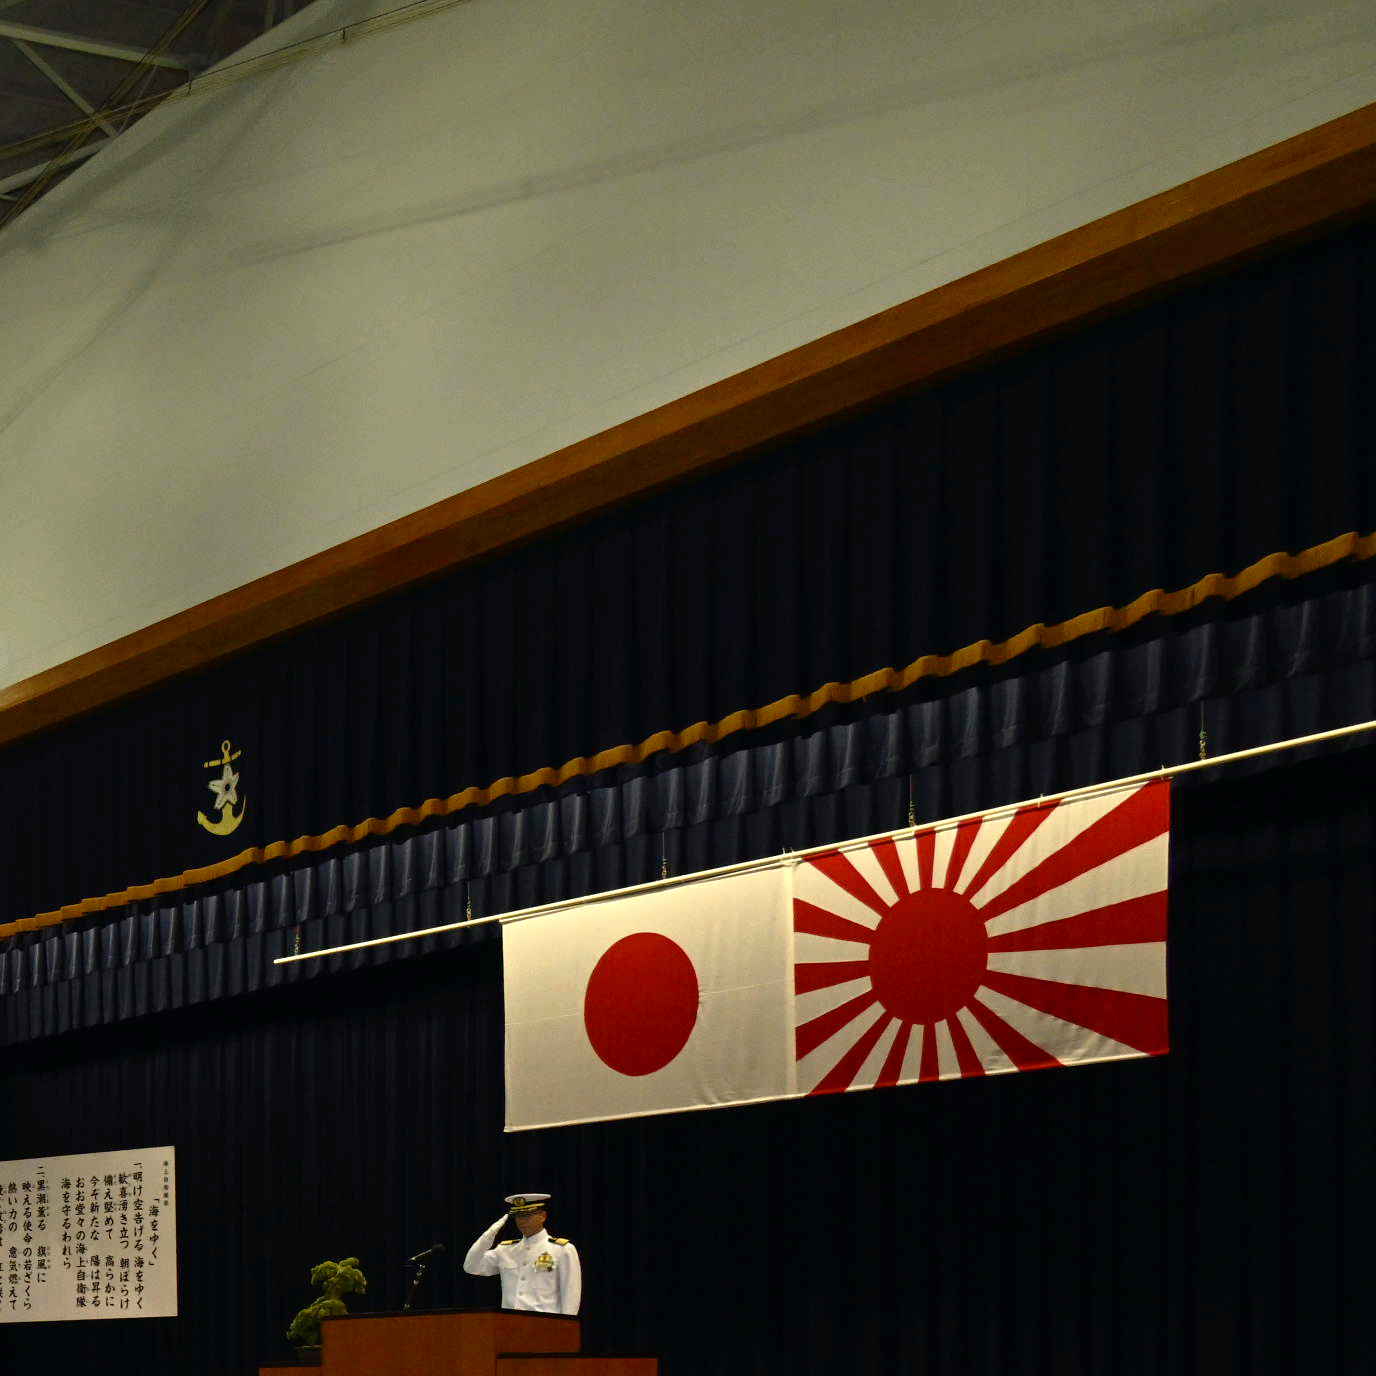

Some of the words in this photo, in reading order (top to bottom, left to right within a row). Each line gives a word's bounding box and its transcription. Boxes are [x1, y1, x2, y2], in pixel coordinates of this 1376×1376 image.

[61, 1178, 72, 1269] 海を守るわれら
[90, 1176, 100, 1241] 今ぞ新たな
[149, 1198, 160, 1266] 「海をゆく」
[105, 1255, 115, 1307] 高らかに
[119, 1258, 130, 1310] 朝ぼらけ
[133, 1257, 145, 1310] 海をゆく
